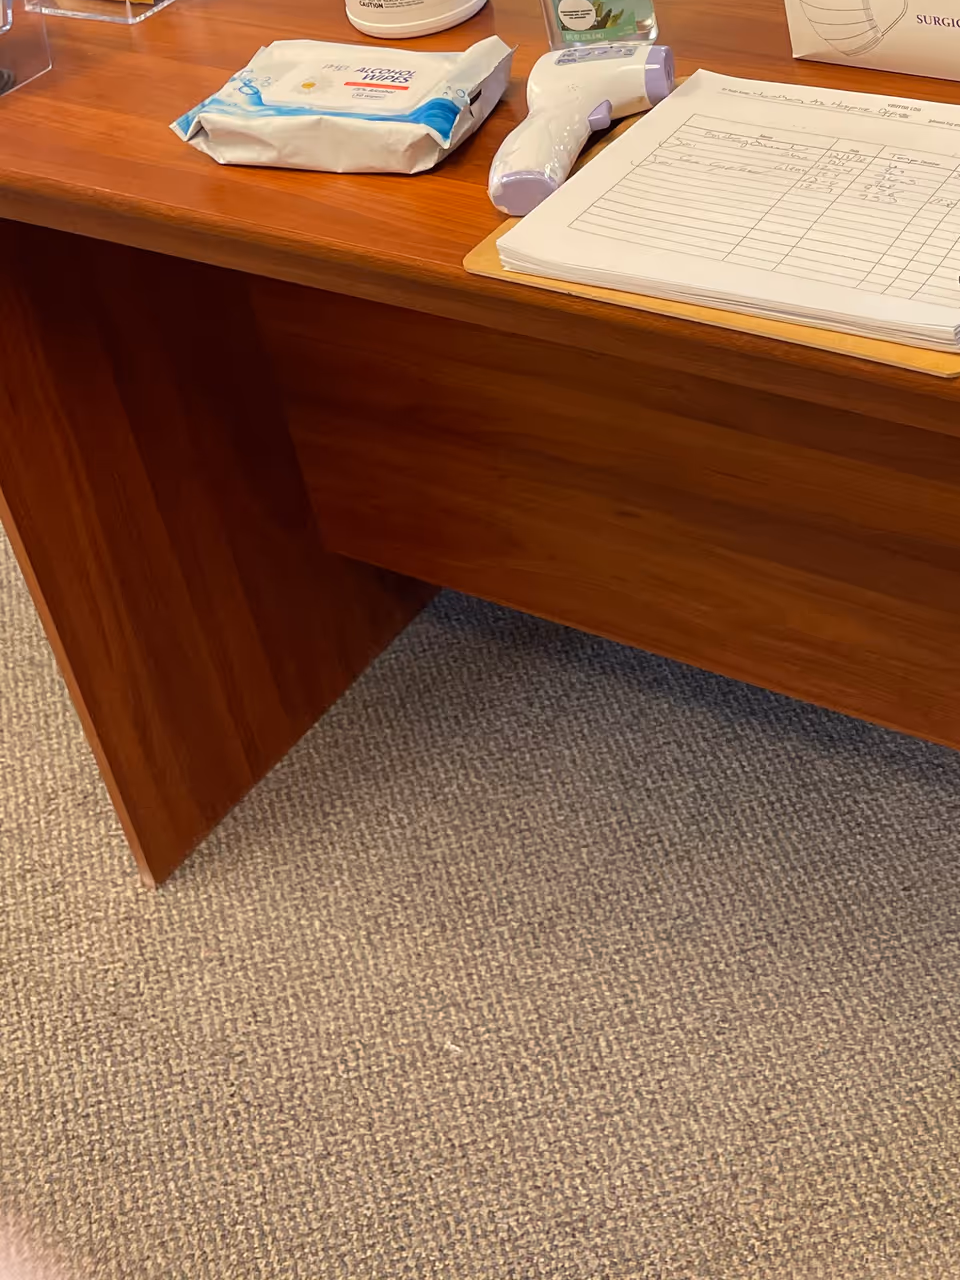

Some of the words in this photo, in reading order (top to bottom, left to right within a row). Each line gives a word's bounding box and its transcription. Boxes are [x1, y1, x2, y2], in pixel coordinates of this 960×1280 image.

[359, 1, 384, 9] CAUTION
[354, 67, 416, 77] ALCOHOL
[362, 74, 412, 83] WIPES
